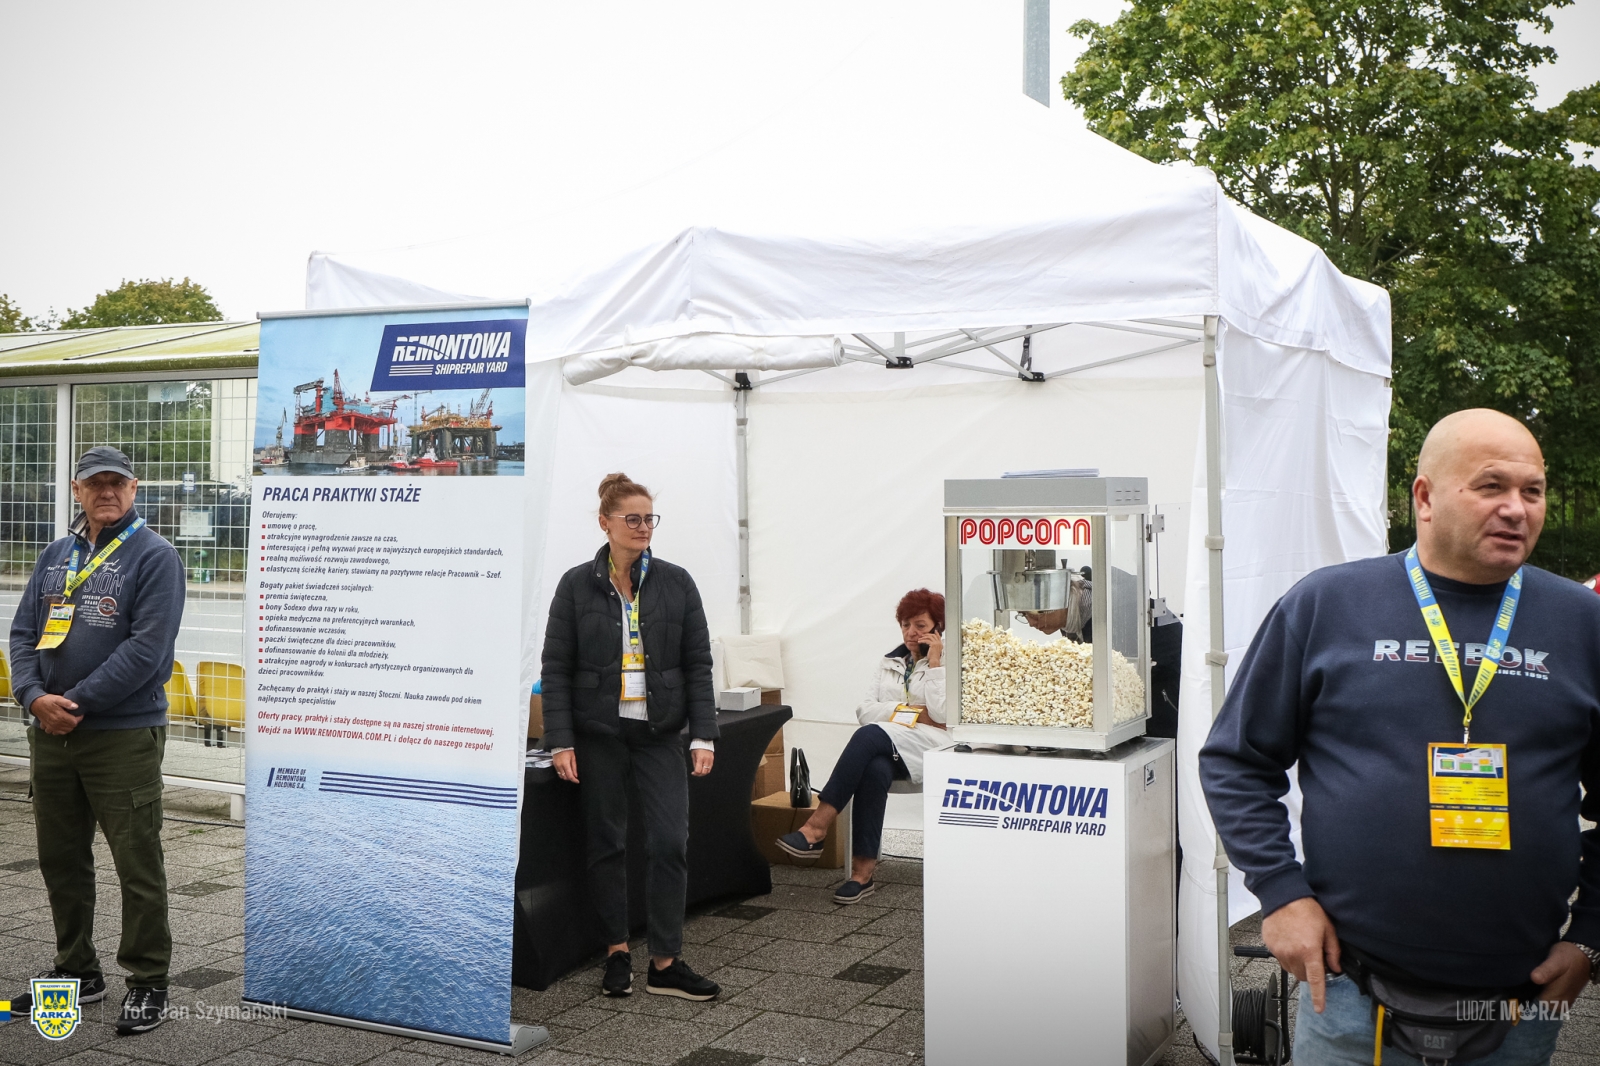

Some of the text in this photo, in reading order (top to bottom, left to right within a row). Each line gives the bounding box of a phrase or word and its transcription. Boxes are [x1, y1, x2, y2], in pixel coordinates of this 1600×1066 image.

[392, 332, 511, 362] REMONTOWA
[435, 362, 508, 375] SHIPREPAIR YARD
[263, 484, 421, 502] PRACA PRAKTYKI STAŻE
[262, 511, 297, 520] Oferujemy:
[299, 523, 317, 531] pracę,
[267, 533, 301, 541] atrakcyjne
[302, 534, 350, 542] wynagrodzenie
[267, 544, 305, 553] interesującą
[311, 545, 330, 553] pełną
[331, 545, 356, 553] wyzwań
[357, 546, 374, 554] pracę
[383, 546, 421, 555] najwyższych
[423, 546, 462, 556] europejskich
[464, 548, 504, 556] standardach,
[266, 555, 288, 563] realną
[289, 555, 322, 563] możliwość
[350, 557, 390, 565] zawodowego,
[266, 565, 300, 574] elastyczną
[302, 566, 326, 574] ścieżkę
[351, 568, 379, 576] stawiamy
[390, 569, 423, 577] pozytywne
[424, 569, 446, 578] relacje
[448, 570, 479, 578] Pracownik
[486, 570, 502, 579] Szef.
[260, 582, 373, 592] Bogaty pakiet świadczeń socjalnych:
[265, 593, 288, 602] premia
[265, 603, 282, 611] bony
[345, 606, 359, 614] roku,
[265, 614, 288, 622] opieka
[289, 615, 321, 623] medyczna
[332, 616, 378, 625] preferencyjnych
[380, 618, 415, 627] warunkach,
[265, 625, 316, 633] dofinansowanie
[265, 636, 286, 644] paczki
[288, 636, 324, 645] świąteczne
[336, 637, 353, 645] dzieci
[265, 646, 316, 655] dofinansowanie
[318, 647, 326, 655] do
[327, 648, 346, 656] kolonii
[264, 657, 298, 666] atrakcyjne
[300, 659, 327, 667] nagrody
[334, 659, 368, 668] konkursach
[370, 661, 411, 671] artystycznych
[412, 664, 463, 674] organizowanych
[464, 667, 473, 675] dla
[258, 684, 295, 693] Zachęcamy
[297, 685, 305, 693] do
[307, 686, 329, 694] praktyk
[334, 687, 349, 696] staży
[358, 689, 377, 698] naszej
[378, 690, 402, 699] Stoczni.
[404, 692, 424, 700] Nauka
[425, 694, 450, 702] zawodu
[451, 695, 463, 704] pod
[464, 696, 482, 704] okiem
[258, 696, 336, 705] najlepszych specjalistów
[258, 711, 280, 721] Oferty
[281, 713, 302, 722] pracy,
[305, 713, 328, 722] praktyk
[334, 715, 350, 725] staży
[352, 717, 381, 727] dostępne
[384, 720, 391, 729] są
[403, 721, 425, 731] naszej
[426, 722, 450, 731] stronie
[451, 723, 494, 736] internetowej.
[258, 726, 281, 735] Wejdź
[294, 727, 392, 742] WWW.REMONTOWA.COM.PL
[398, 734, 421, 745] dołącz
[423, 736, 432, 745] do
[434, 737, 463, 749] naszego
[465, 739, 494, 750] zespołu!
[942, 778, 1109, 818] REMONTOWA
[1002, 817, 1106, 836] SHIPREPAIR YARD
[1424, 1034, 1446, 1049] CAT
